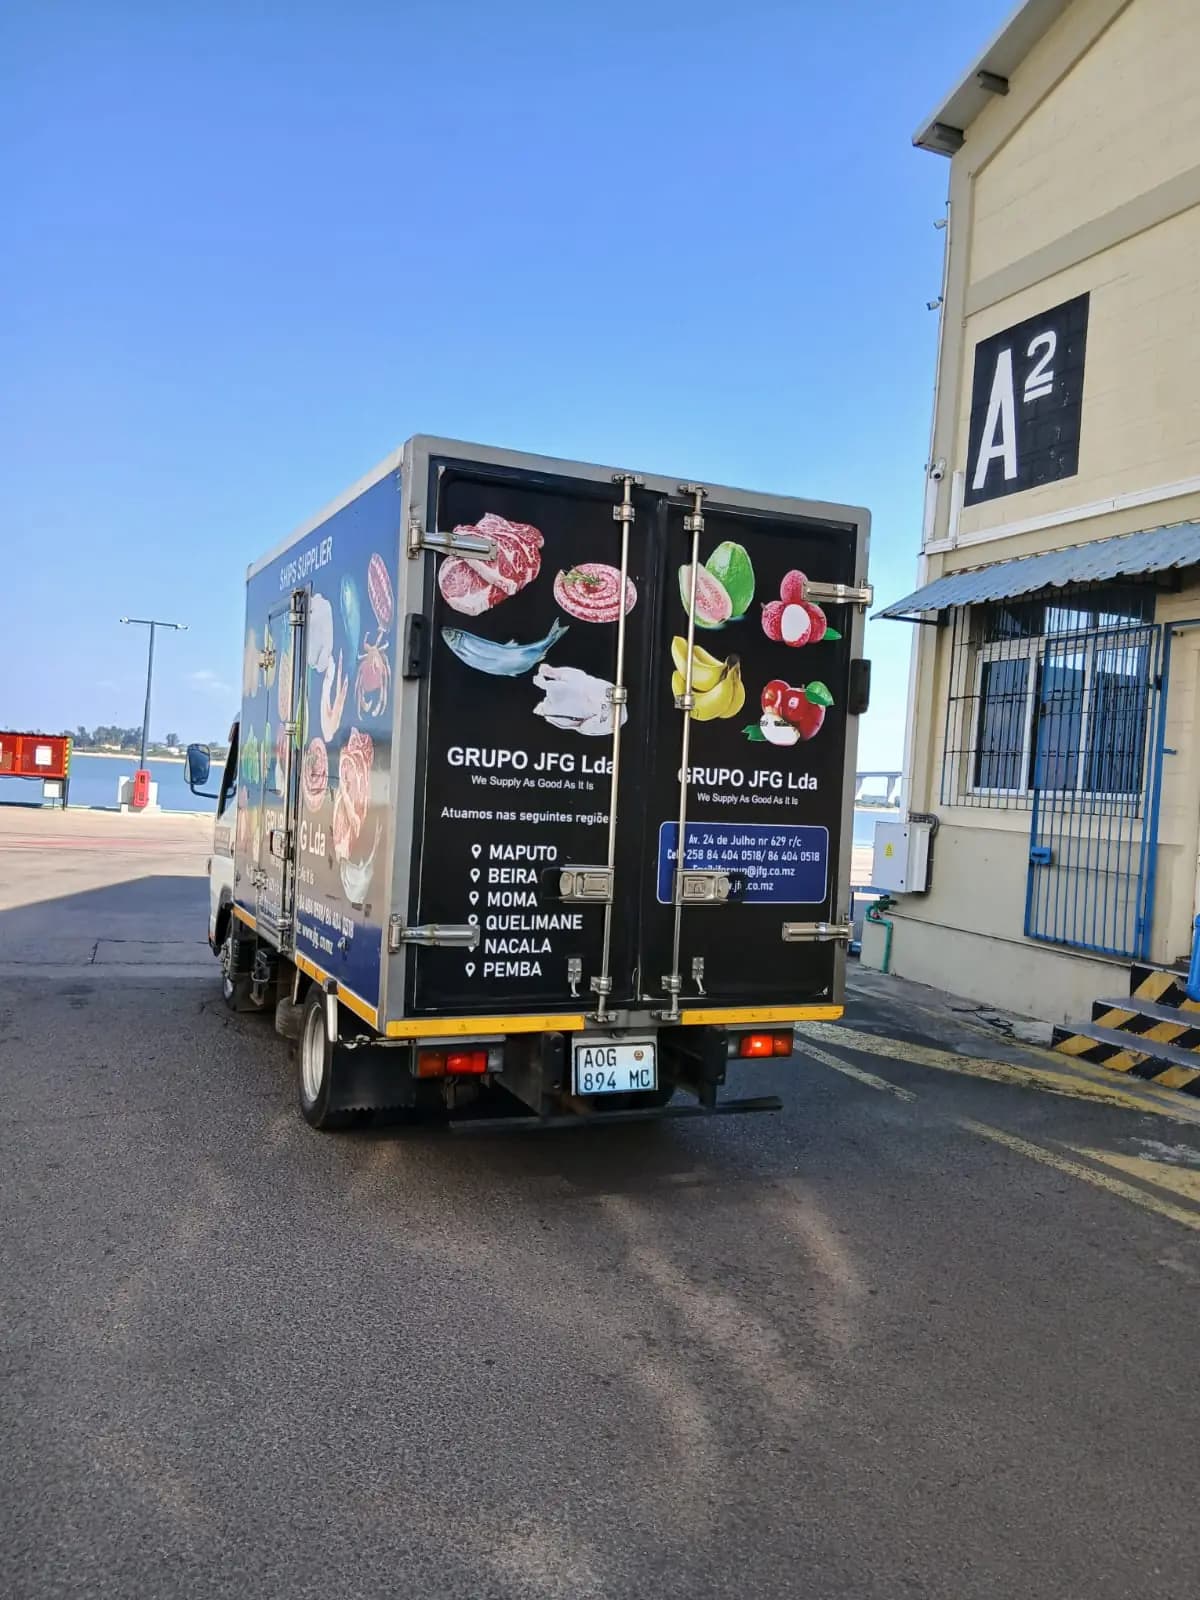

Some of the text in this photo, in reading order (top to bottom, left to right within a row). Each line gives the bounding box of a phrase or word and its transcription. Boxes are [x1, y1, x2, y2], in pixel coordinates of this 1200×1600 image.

[297, 535, 333, 580] SUPPLIER
[447, 746, 614, 774] GRUPO JFG Lda
[471, 775, 594, 790] We Supply As Good As It Is
[677, 767, 818, 790] GRUPO JFG Lda
[697, 792, 798, 806] We Supply As Good As It Is
[441, 807, 614, 826] Atuamos nas seguintes regiõe
[688, 834, 802, 848] Av. 24 de Julho nr 629 r/c
[489, 844, 558, 861] MAPUTO
[706, 849, 719, 860] 84
[721, 850, 739, 860] 404
[768, 850, 779, 861] 86
[781, 851, 798, 861] 404
[800, 851, 820, 862] 0518
[488, 868, 538, 884] BEIRA
[487, 891, 538, 907] MOMA
[486, 914, 583, 931] QUELIMANE
[484, 938, 552, 954] NACALA
[483, 961, 542, 977] PEMBA
[584, 1048, 617, 1068] AOG
[584, 1069, 650, 1091] 894 MC
